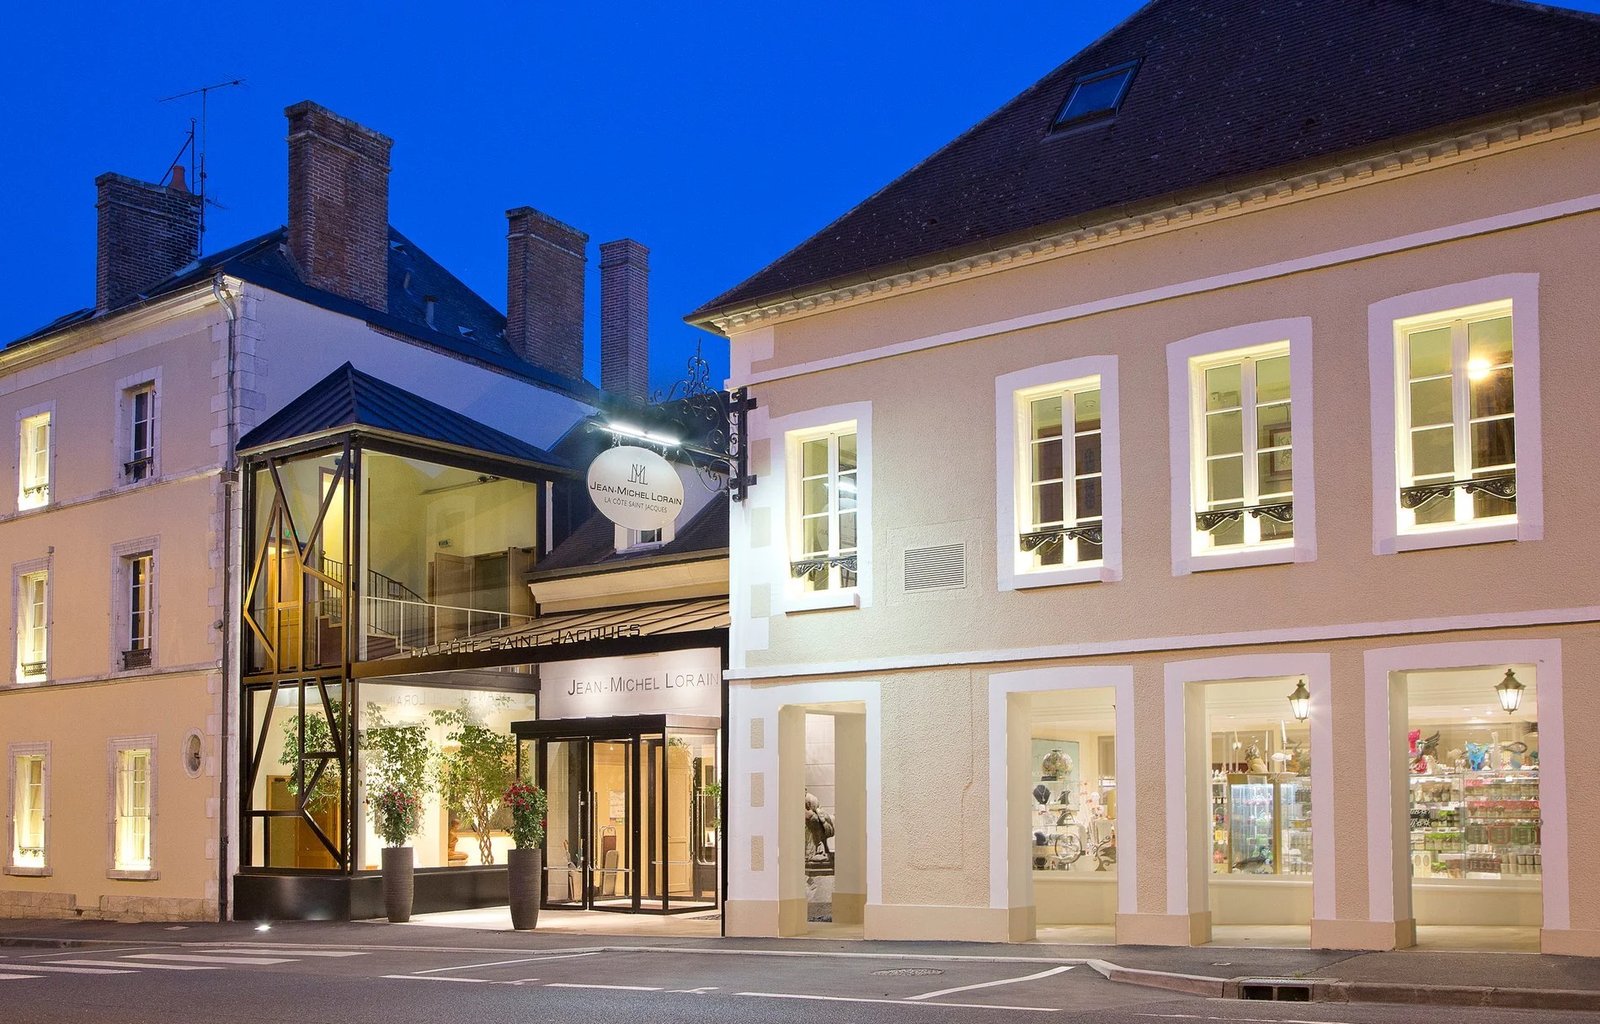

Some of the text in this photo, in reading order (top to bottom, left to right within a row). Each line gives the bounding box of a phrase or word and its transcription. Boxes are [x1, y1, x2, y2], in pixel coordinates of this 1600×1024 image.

[589, 481, 682, 506] JEAN-MICHEL LORAIN
[604, 496, 668, 514] LA CÔTE SAINT JACQUES
[490, 633, 540, 652] SAINT
[551, 624, 641, 644] JACQUES
[567, 672, 719, 696] JEAN-MICHEL LORAIN
